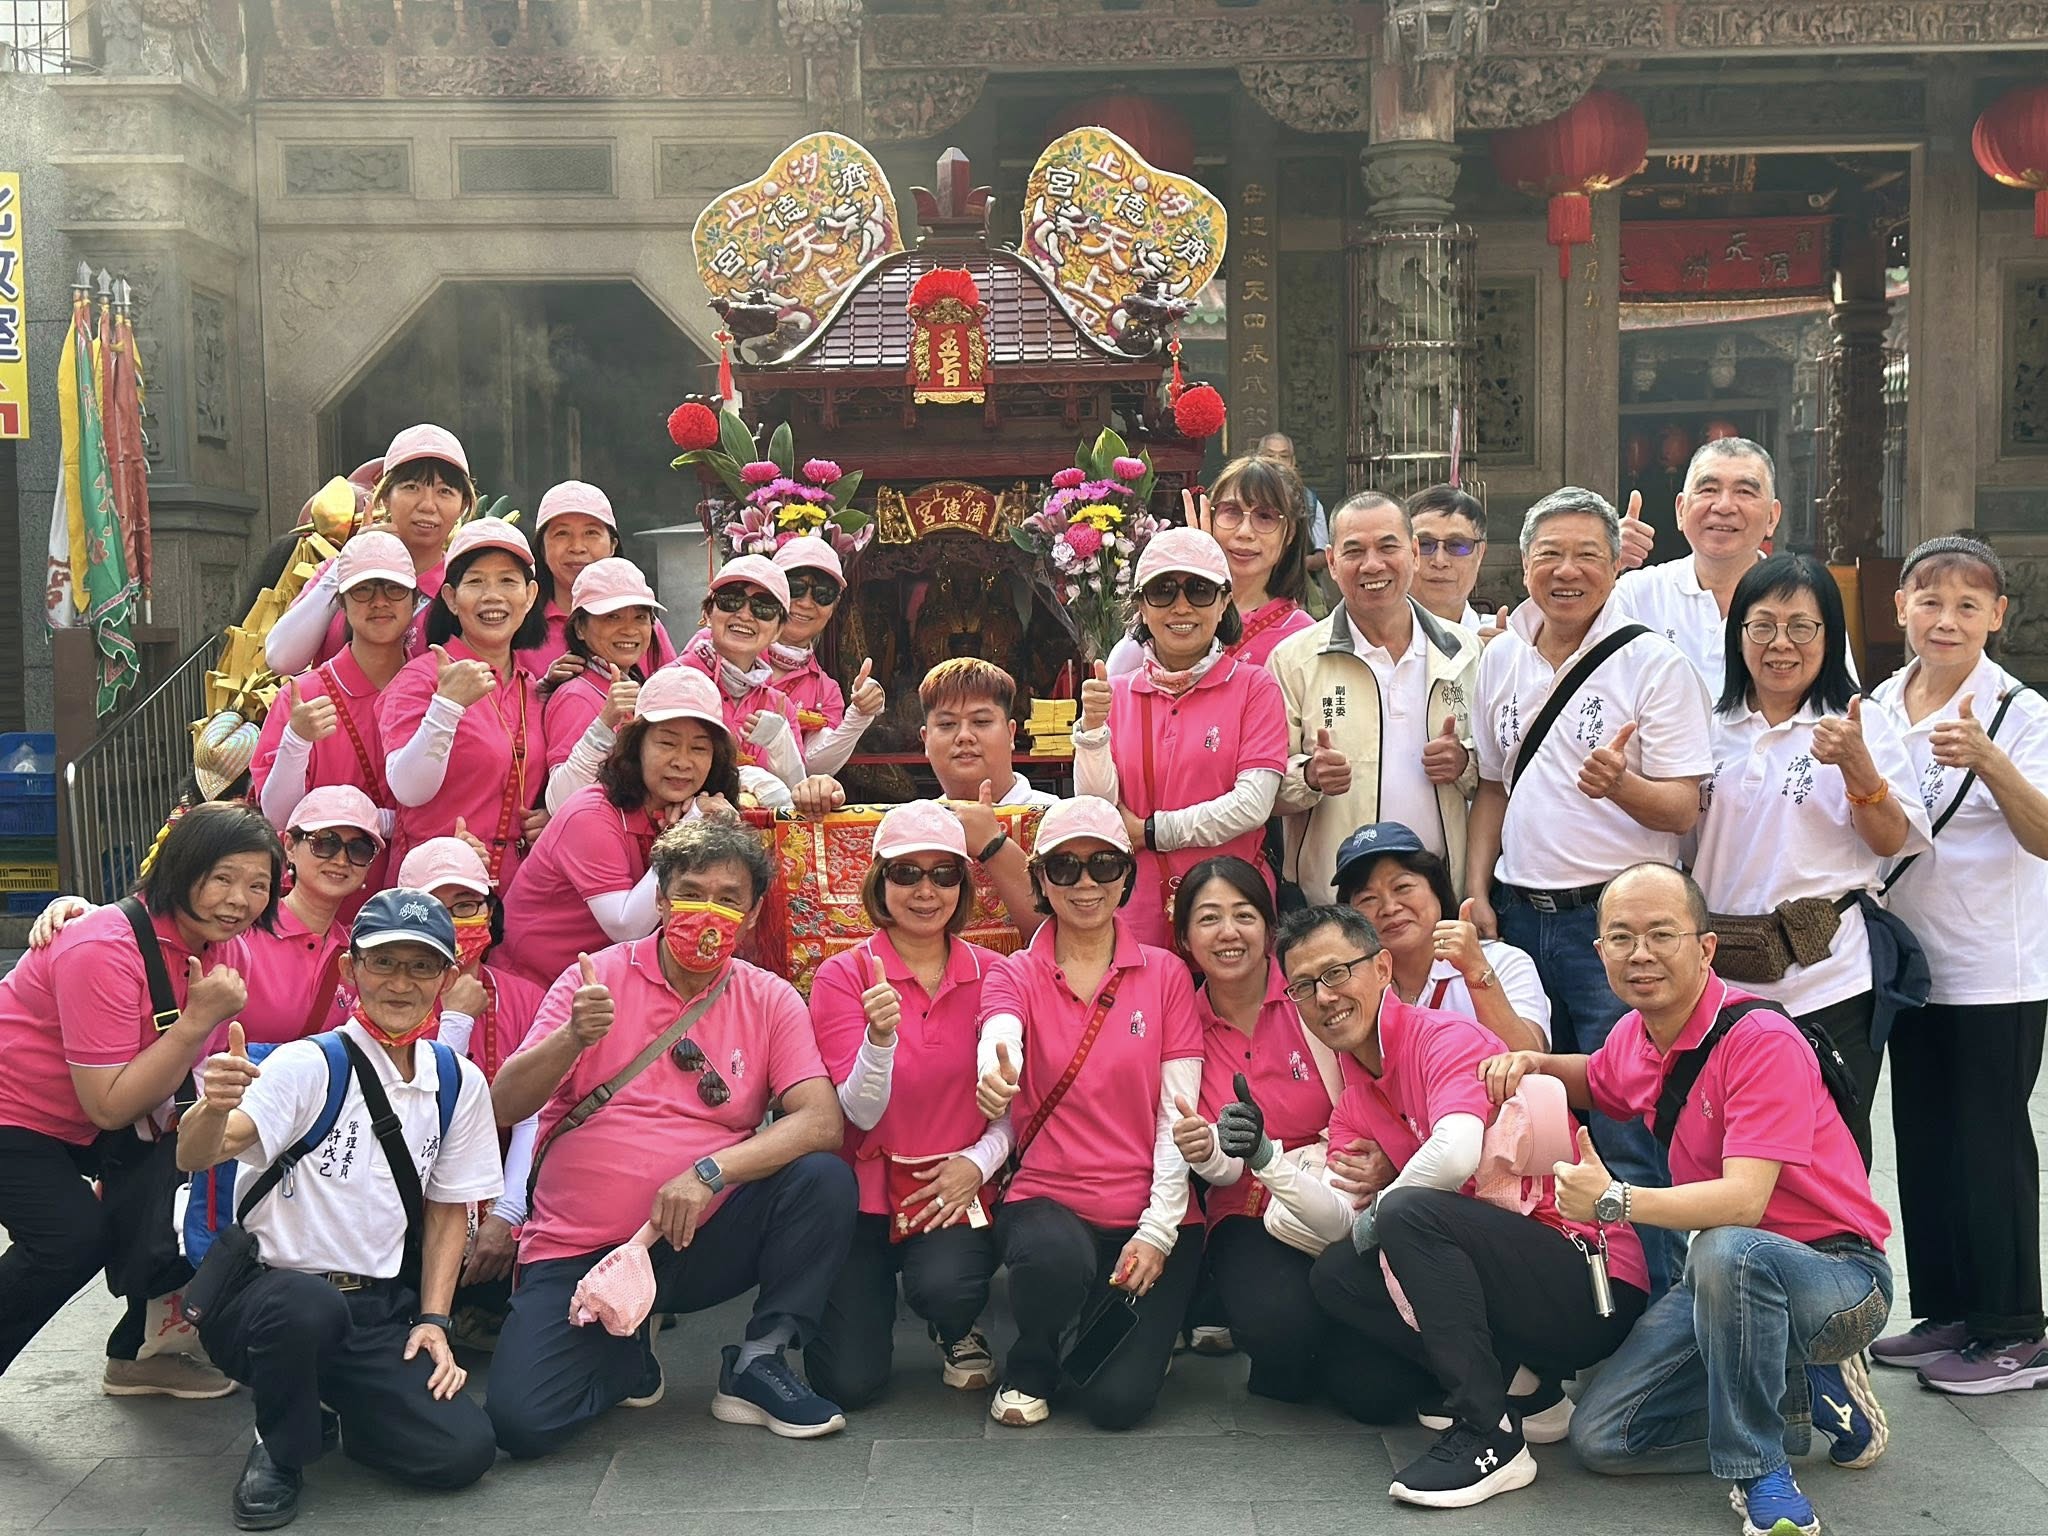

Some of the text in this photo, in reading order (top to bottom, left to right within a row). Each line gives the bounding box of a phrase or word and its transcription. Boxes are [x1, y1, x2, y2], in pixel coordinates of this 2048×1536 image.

[915, 498, 989, 527] 濟德宮
[1322, 698, 1334, 728] 陳安男
[1335, 686, 1346, 717] 副主委
[1580, 696, 1604, 750] 濟德宮
[1787, 755, 1814, 805] 濟德宮
[339, 1121, 359, 1179] 管理委員
